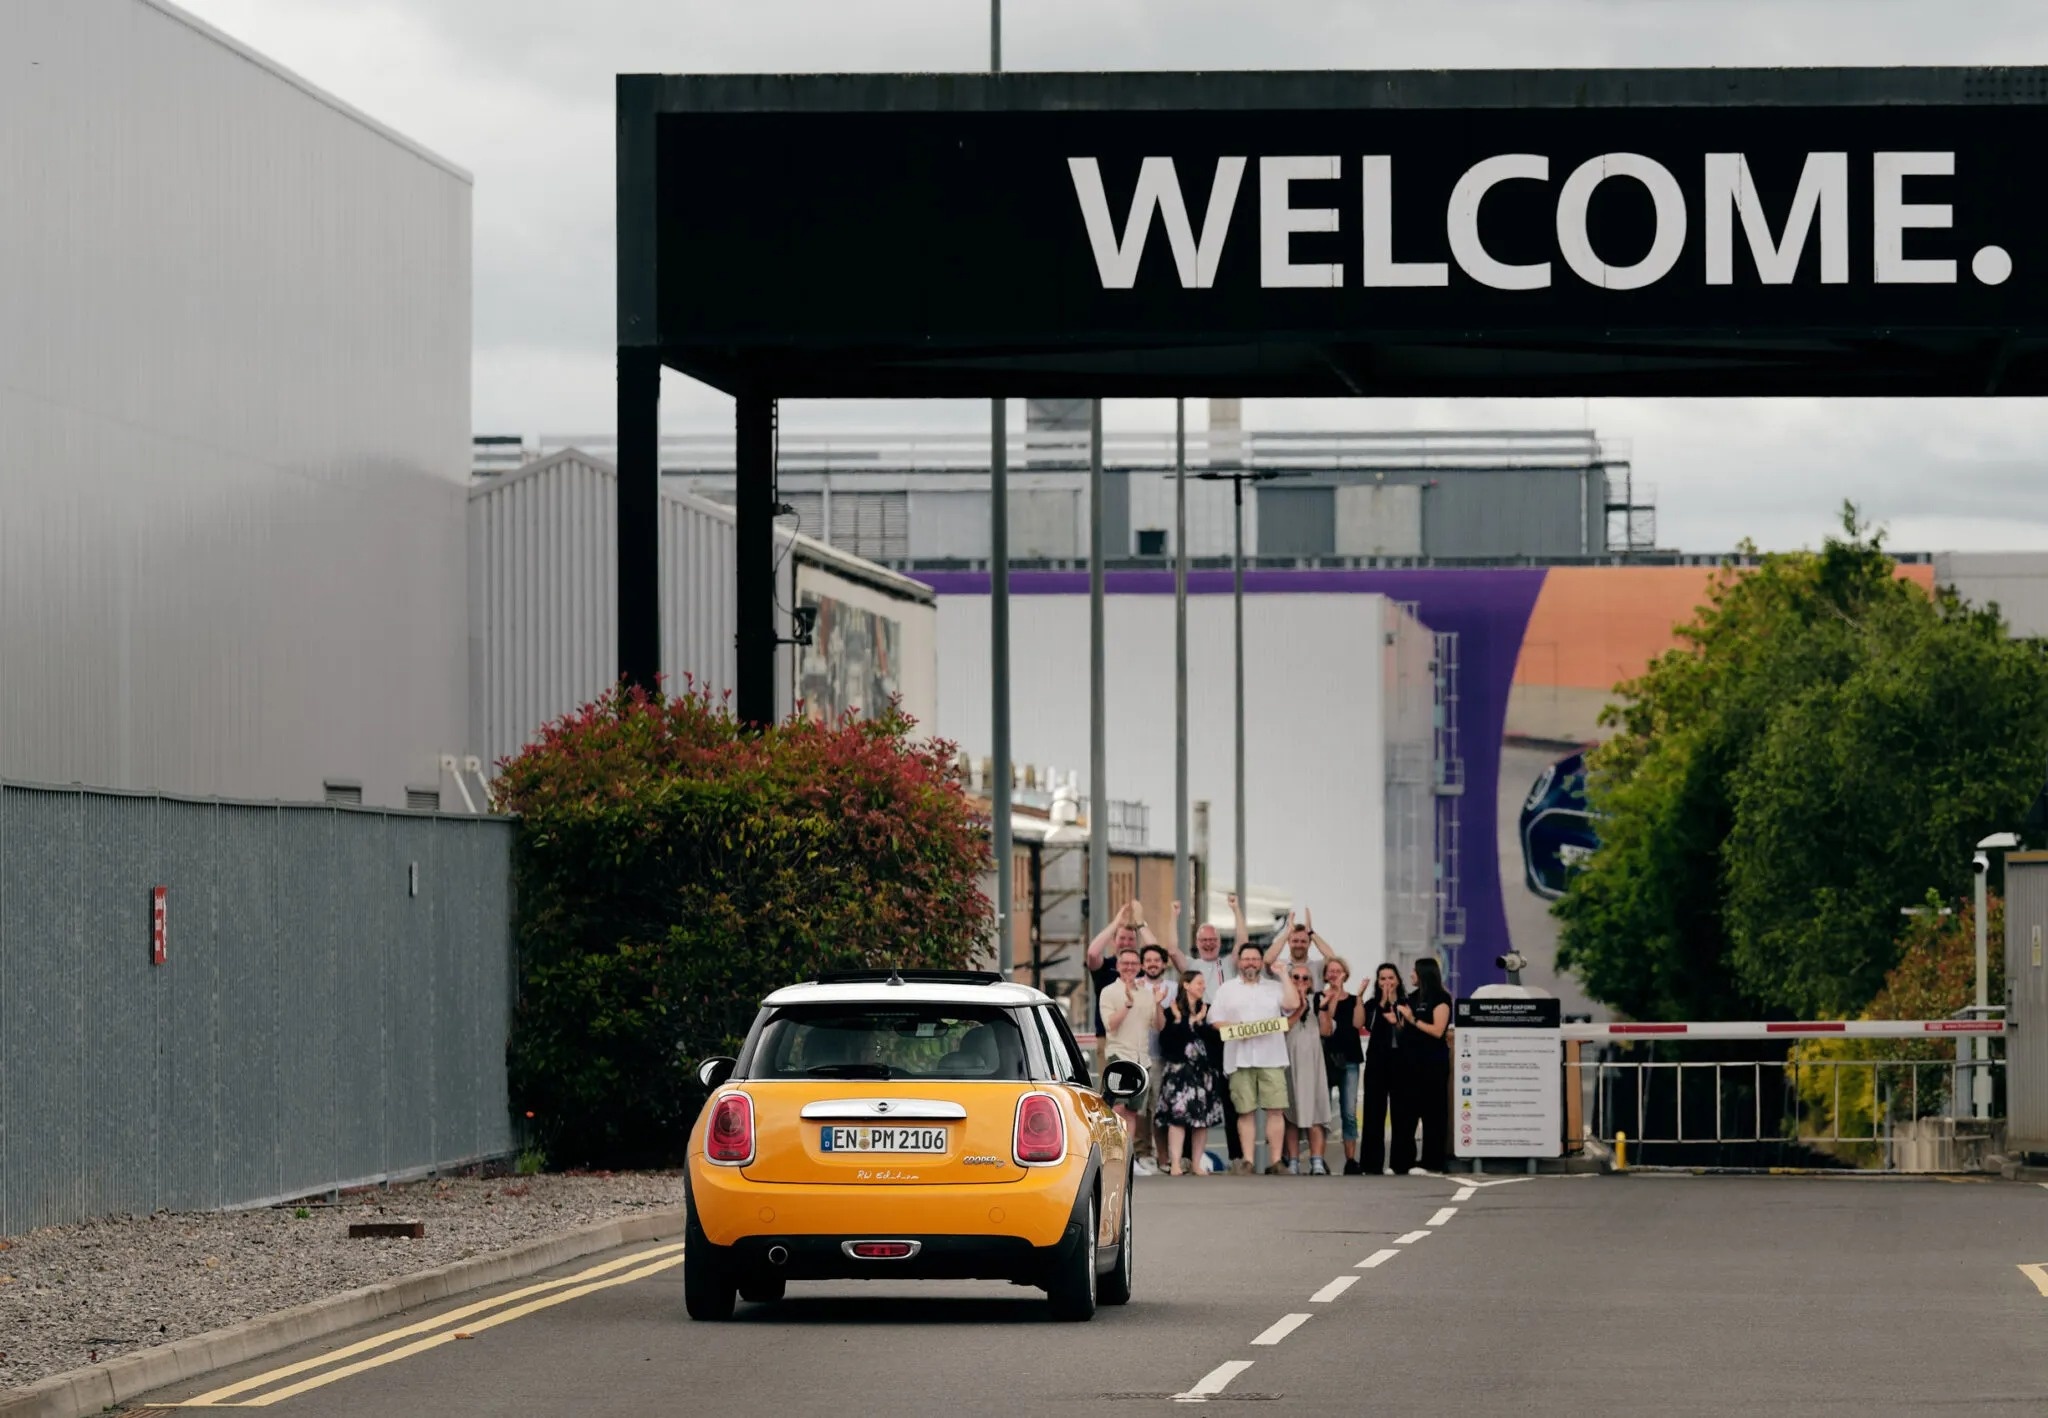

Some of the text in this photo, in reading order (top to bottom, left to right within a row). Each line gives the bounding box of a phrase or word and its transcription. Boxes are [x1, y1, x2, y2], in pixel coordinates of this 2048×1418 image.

[1067, 152, 2013, 290] WELCOME.
[834, 1129, 944, 1150] EN PM 2106
